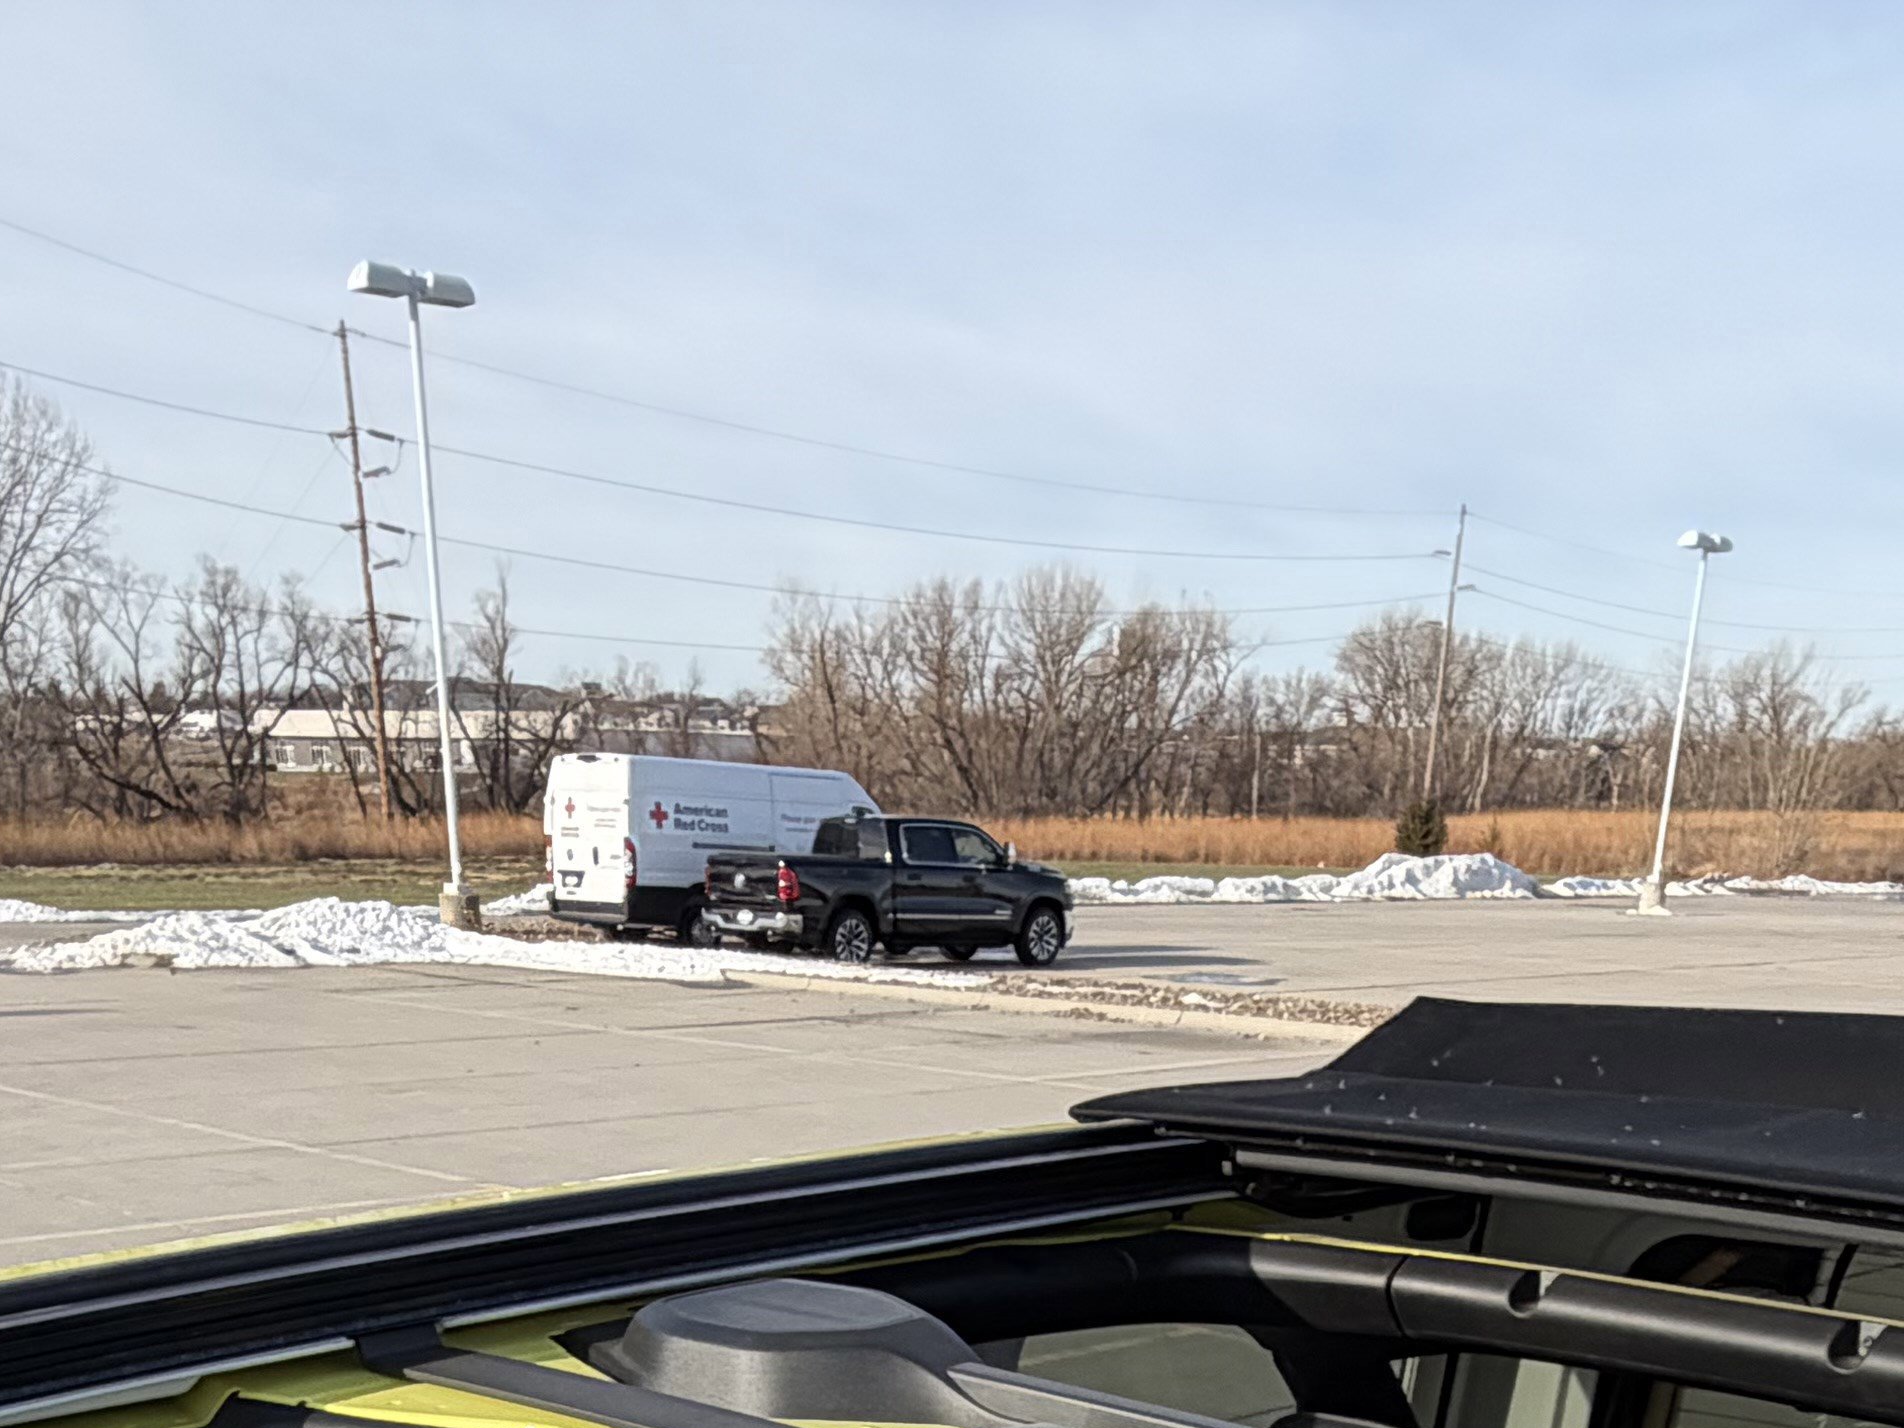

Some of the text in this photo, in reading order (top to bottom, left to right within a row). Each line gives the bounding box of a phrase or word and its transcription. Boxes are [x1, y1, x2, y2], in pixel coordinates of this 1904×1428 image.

[673, 803, 728, 818] American
[673, 817, 729, 833] Red Cross
